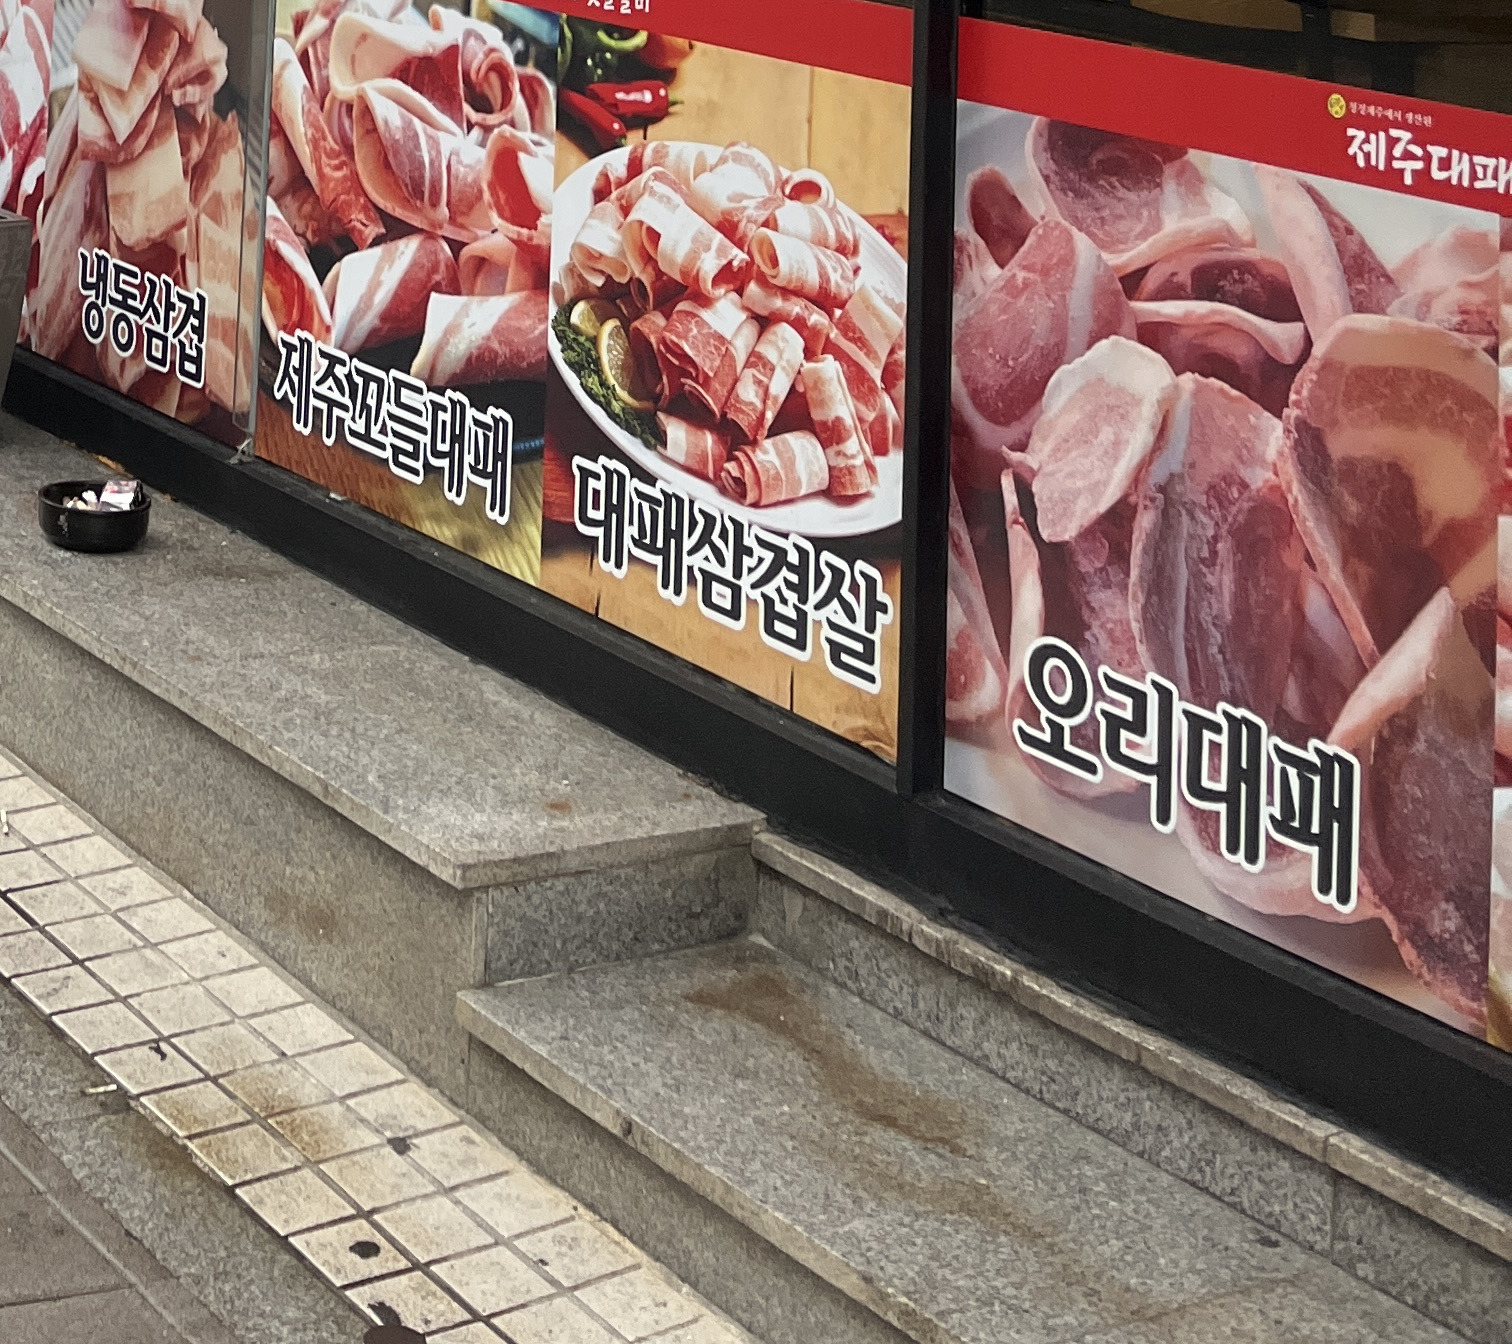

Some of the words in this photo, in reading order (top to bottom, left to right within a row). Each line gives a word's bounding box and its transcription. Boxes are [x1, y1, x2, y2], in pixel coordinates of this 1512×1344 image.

[77, 248, 208, 386] 냉동삼겹
[273, 330, 515, 524] 제주꼬들대패
[573, 452, 893, 695] 대패삼겹살
[1013, 635, 1361, 911] 오리대패
